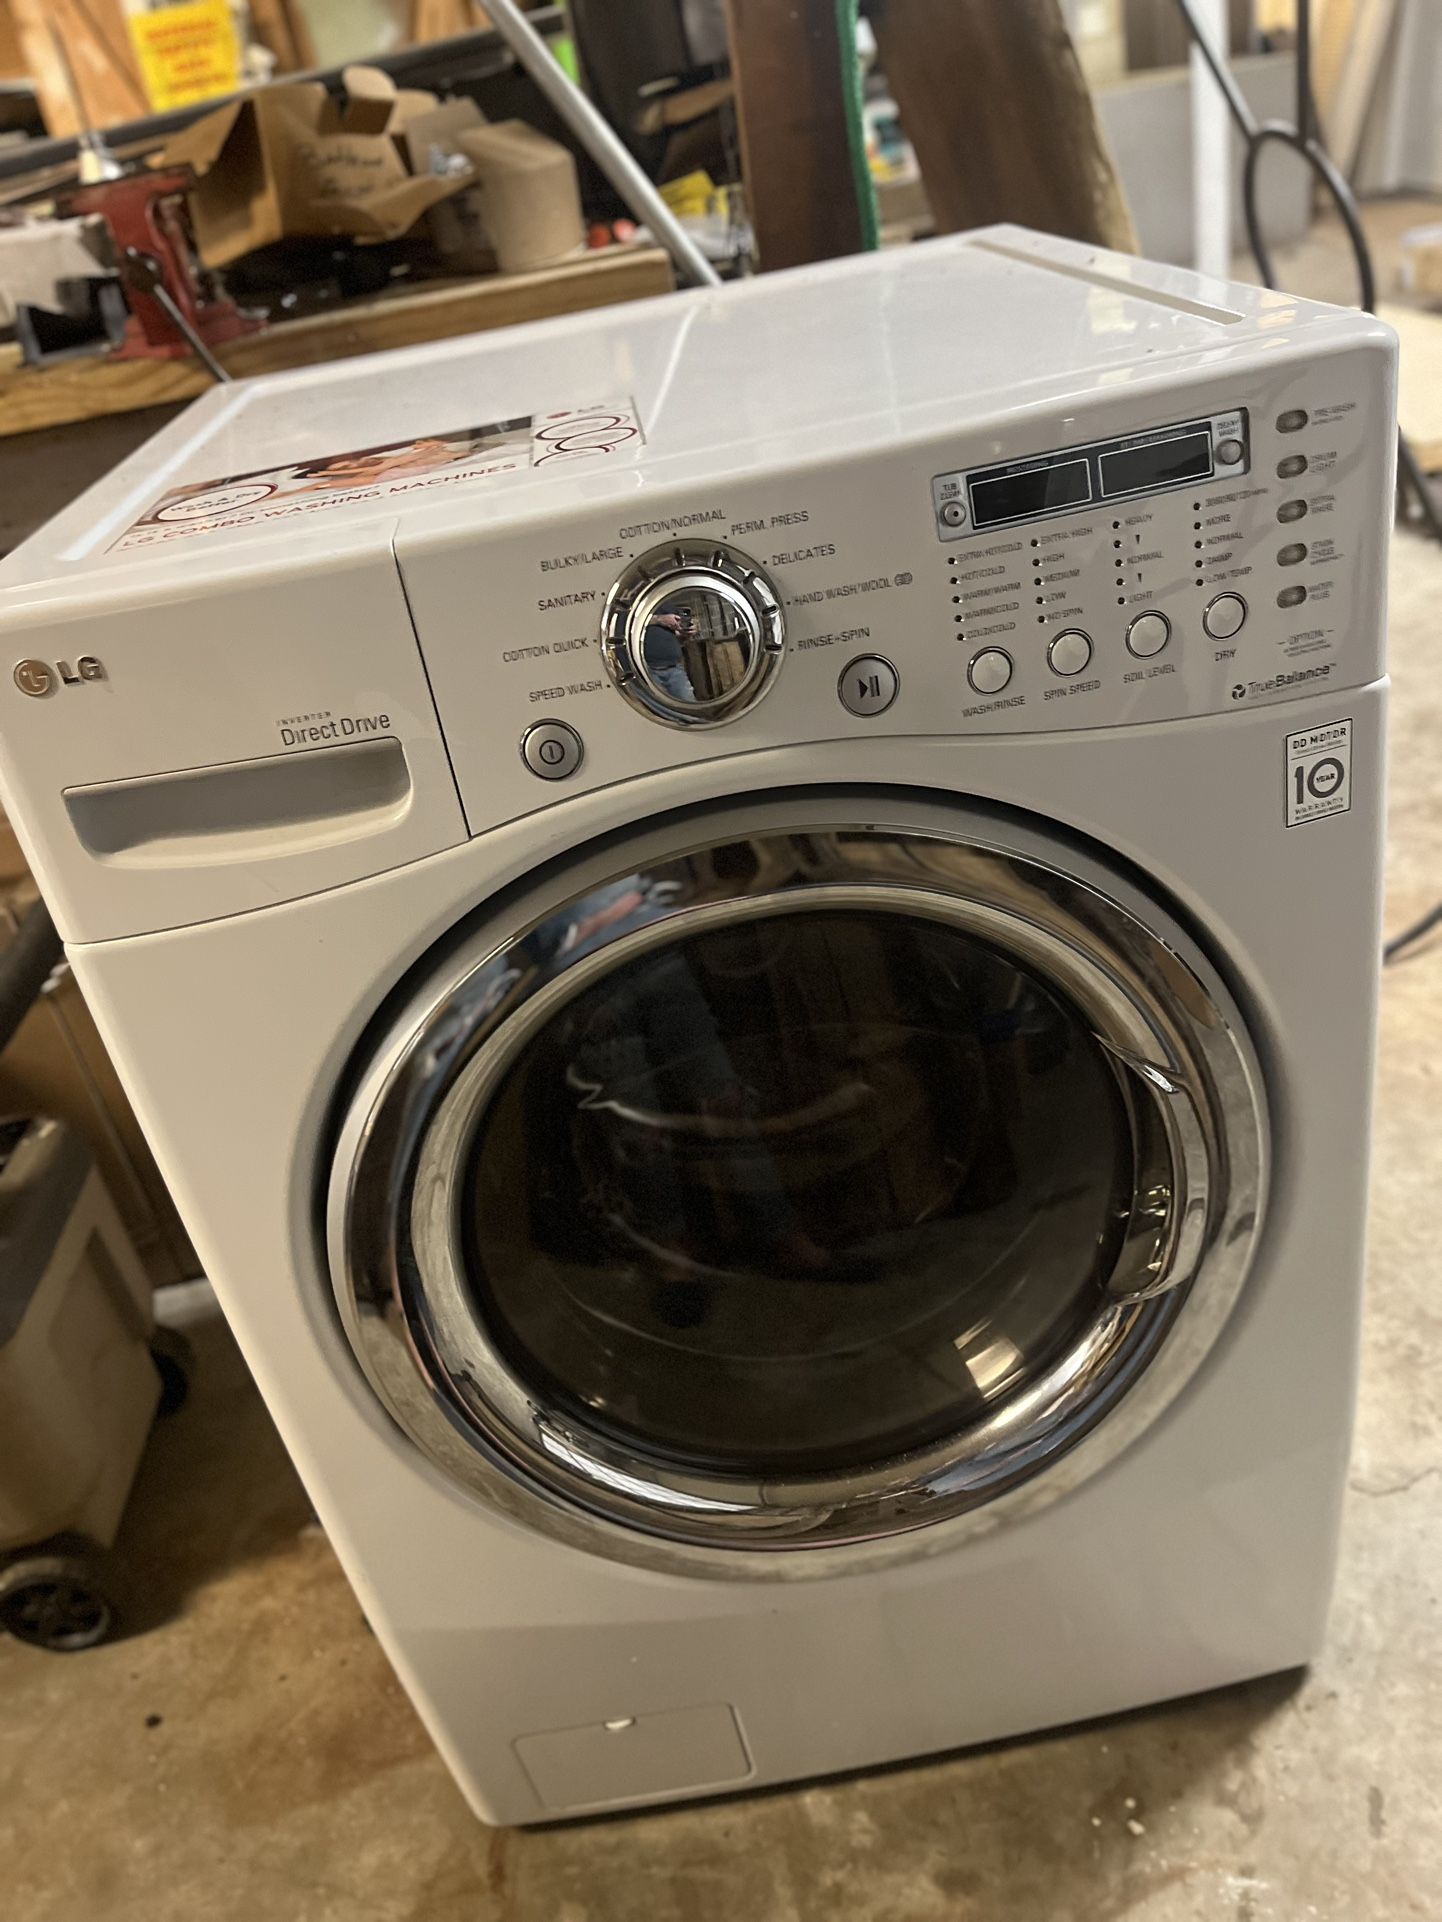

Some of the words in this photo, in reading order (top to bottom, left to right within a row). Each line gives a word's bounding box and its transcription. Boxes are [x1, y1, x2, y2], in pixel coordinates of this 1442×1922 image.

[163, 516, 256, 537] COMBO
[264, 490, 381, 518] WASHING
[389, 463, 517, 493] MACHINES
[619, 509, 727, 539] COTTON/NORMAL
[770, 510, 809, 528] PRESS
[540, 546, 624, 572] BULKY/LARGE
[772, 544, 836, 566] DELICATES
[538, 590, 597, 612] SANITARY
[792, 591, 824, 606] HAND
[503, 647, 550, 663] COTTON
[553, 636, 589, 654] QUICK
[1214, 648, 1237, 662] DRY
[56, 656, 104, 685] LG
[1123, 671, 1146, 684] SOIL
[1147, 663, 1177, 678] LEVEL
[528, 687, 565, 703] SPEED
[567, 680, 603, 696] WASH
[1043, 690, 1067, 701] SPIN
[1069, 679, 1101, 695] SPEED
[962, 695, 1026, 718] WASH/RINSE
[281, 720, 340, 746] Direct
[341, 714, 391, 736] Drive
[1293, 738, 1307, 750] DD
[1310, 727, 1346, 745] MOTOR
[1294, 757, 1345, 805] 10
[1316, 772, 1335, 784] YEAR
